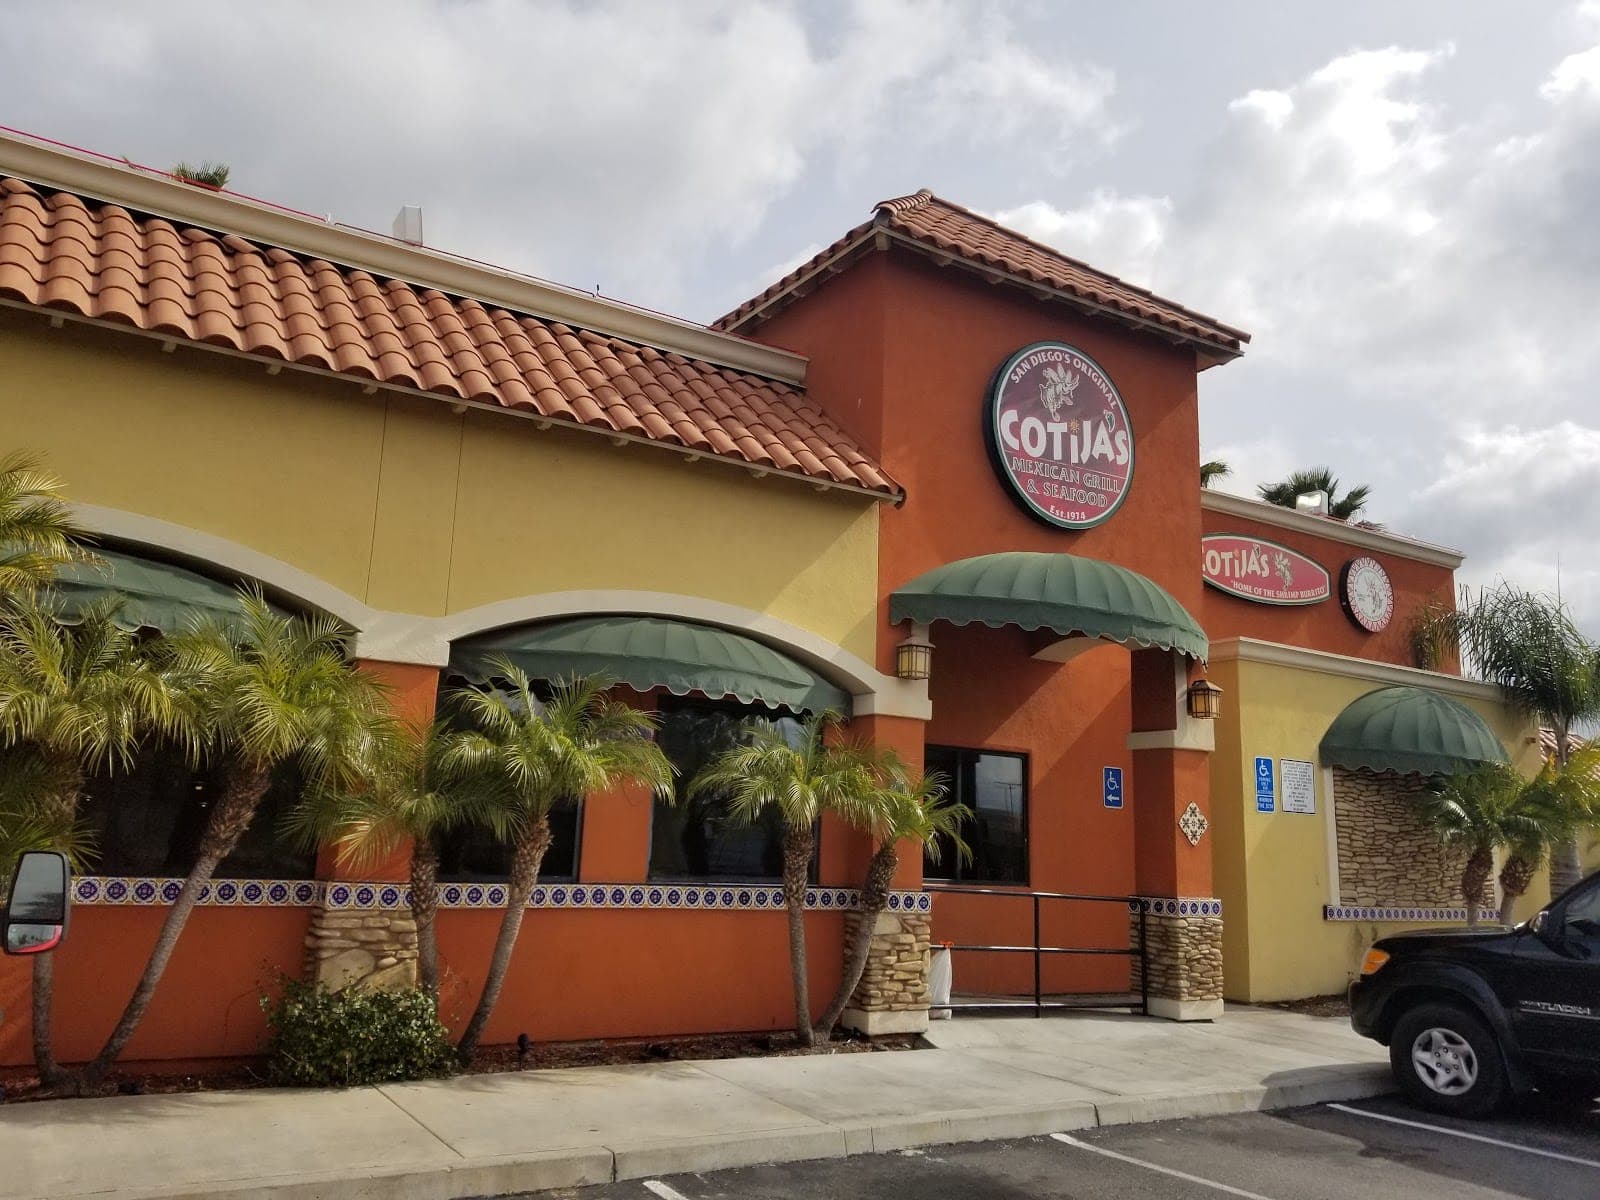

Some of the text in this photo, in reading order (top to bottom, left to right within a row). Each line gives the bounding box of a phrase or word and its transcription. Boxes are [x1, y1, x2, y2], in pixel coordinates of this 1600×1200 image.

[1010, 351, 1117, 409] SAN DIEGO'S ORIGINAL
[1011, 457, 1120, 493] MEXICAN GRILL
[1026, 479, 1108, 508] & SEAFOOD
[1253, 586, 1262, 595] OF
[1263, 589, 1276, 598] THE
[1275, 590, 1300, 599] SHRIMP
